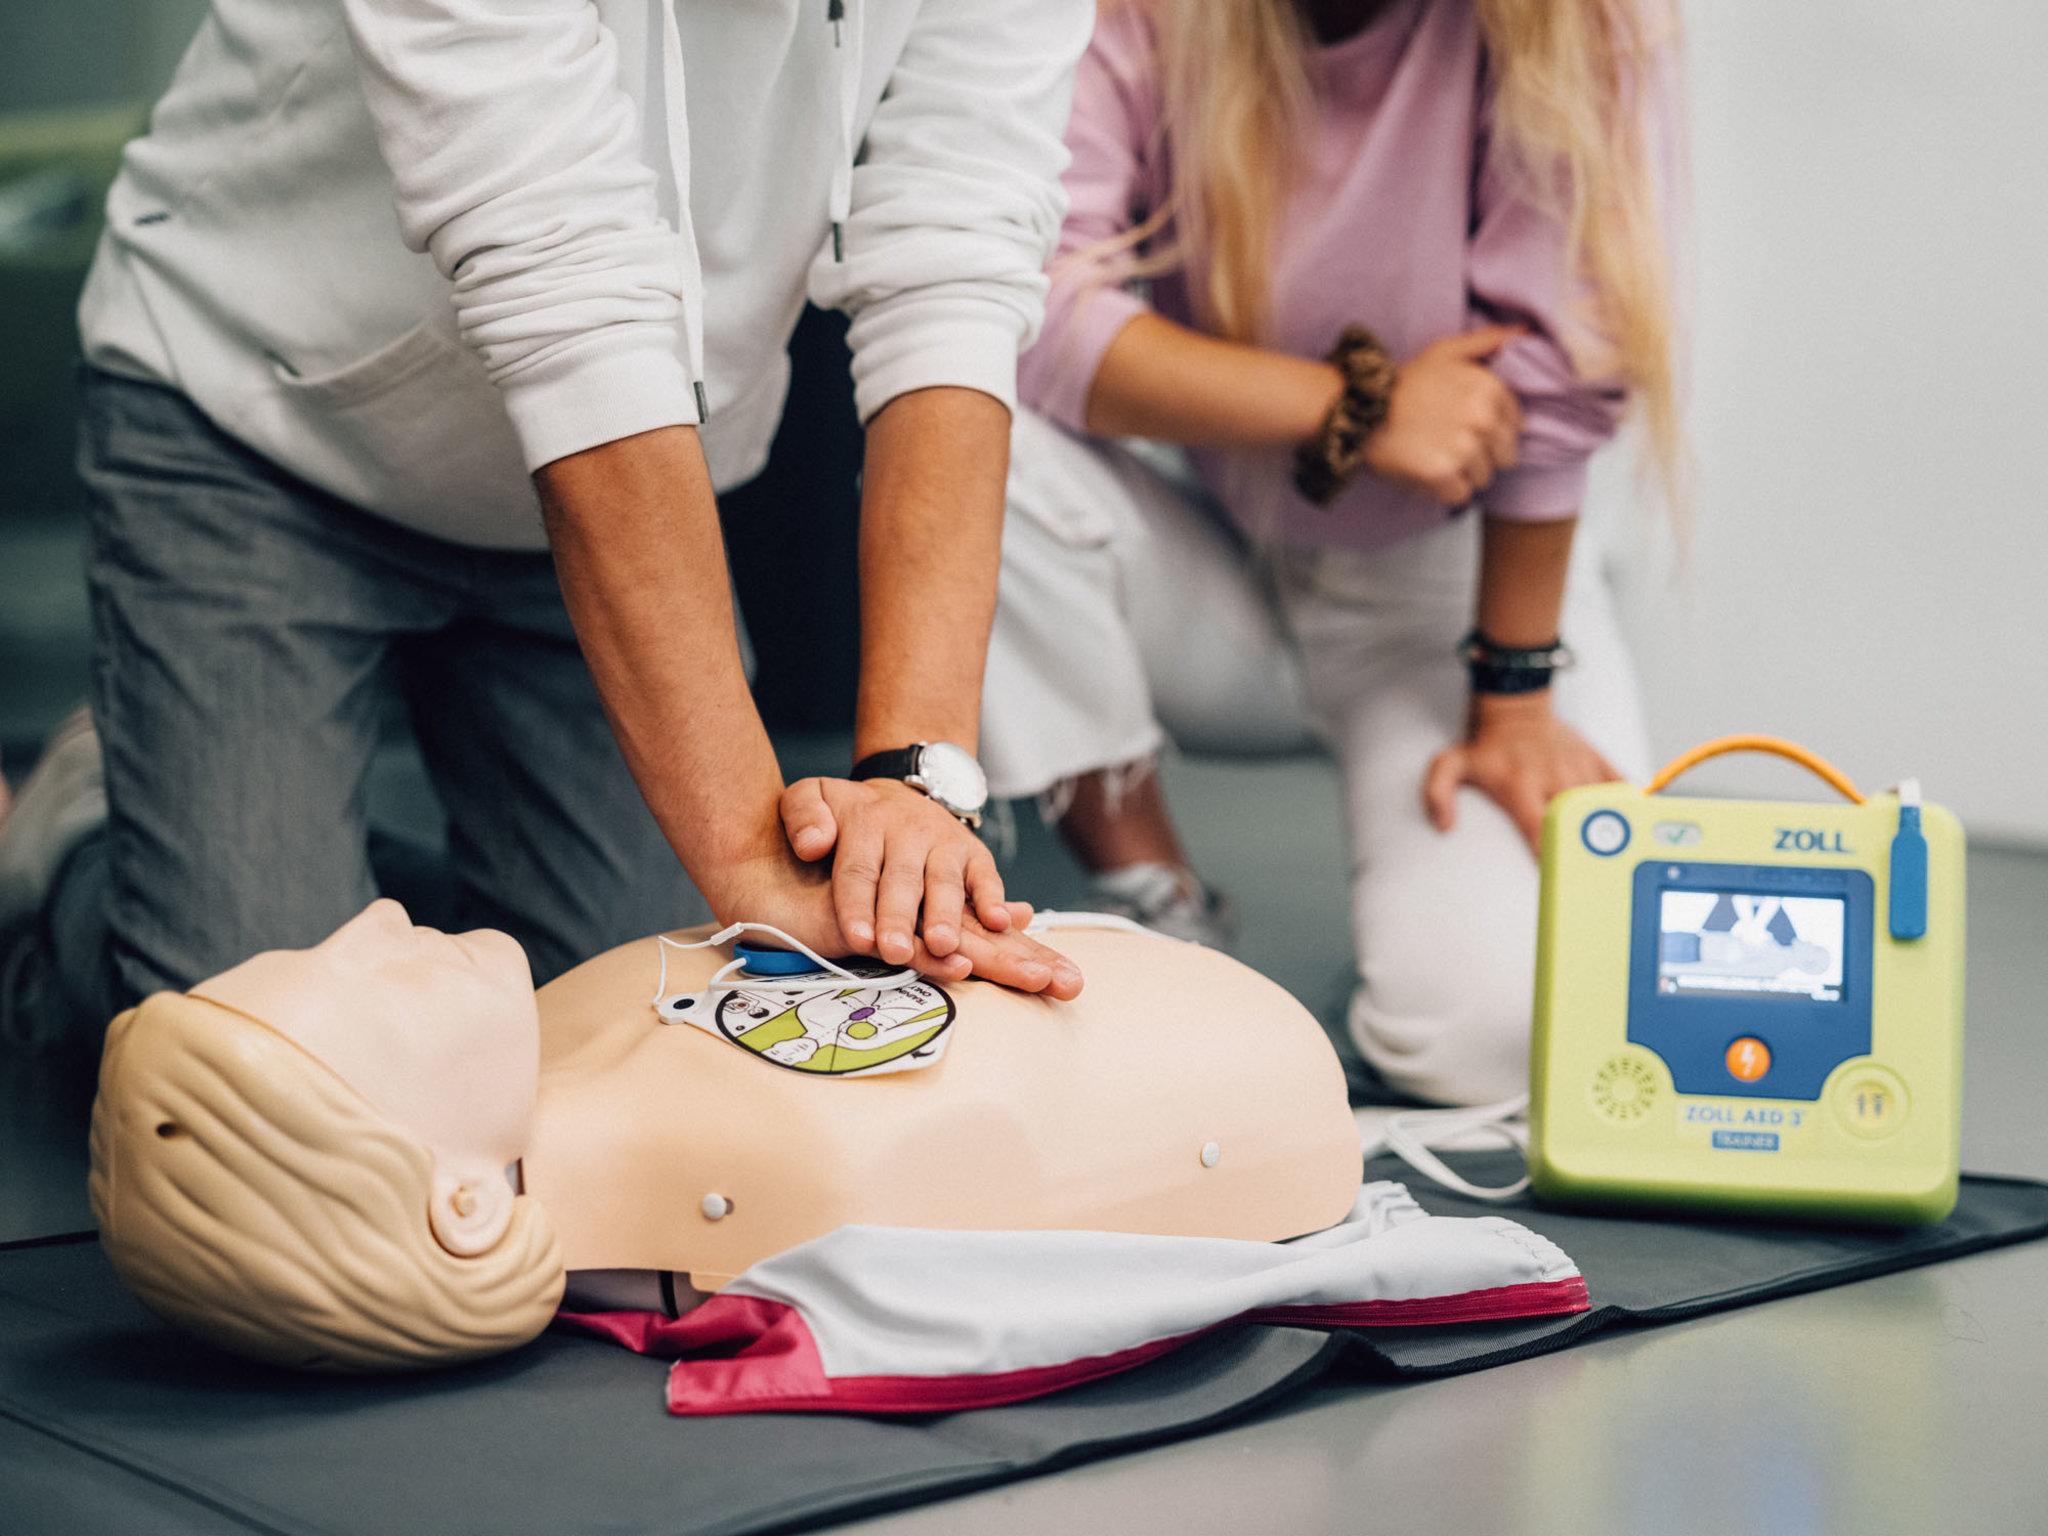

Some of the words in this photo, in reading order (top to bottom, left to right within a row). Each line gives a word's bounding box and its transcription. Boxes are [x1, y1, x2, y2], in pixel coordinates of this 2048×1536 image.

[1773, 828, 1853, 853] ZOLL
[907, 985, 932, 998] ONLY
[1685, 1104, 1737, 1124] ZOLL
[1742, 1107, 1785, 1126] AED
[1789, 1108, 1803, 1128] 3
[1717, 1131, 1775, 1149] TRAINER
